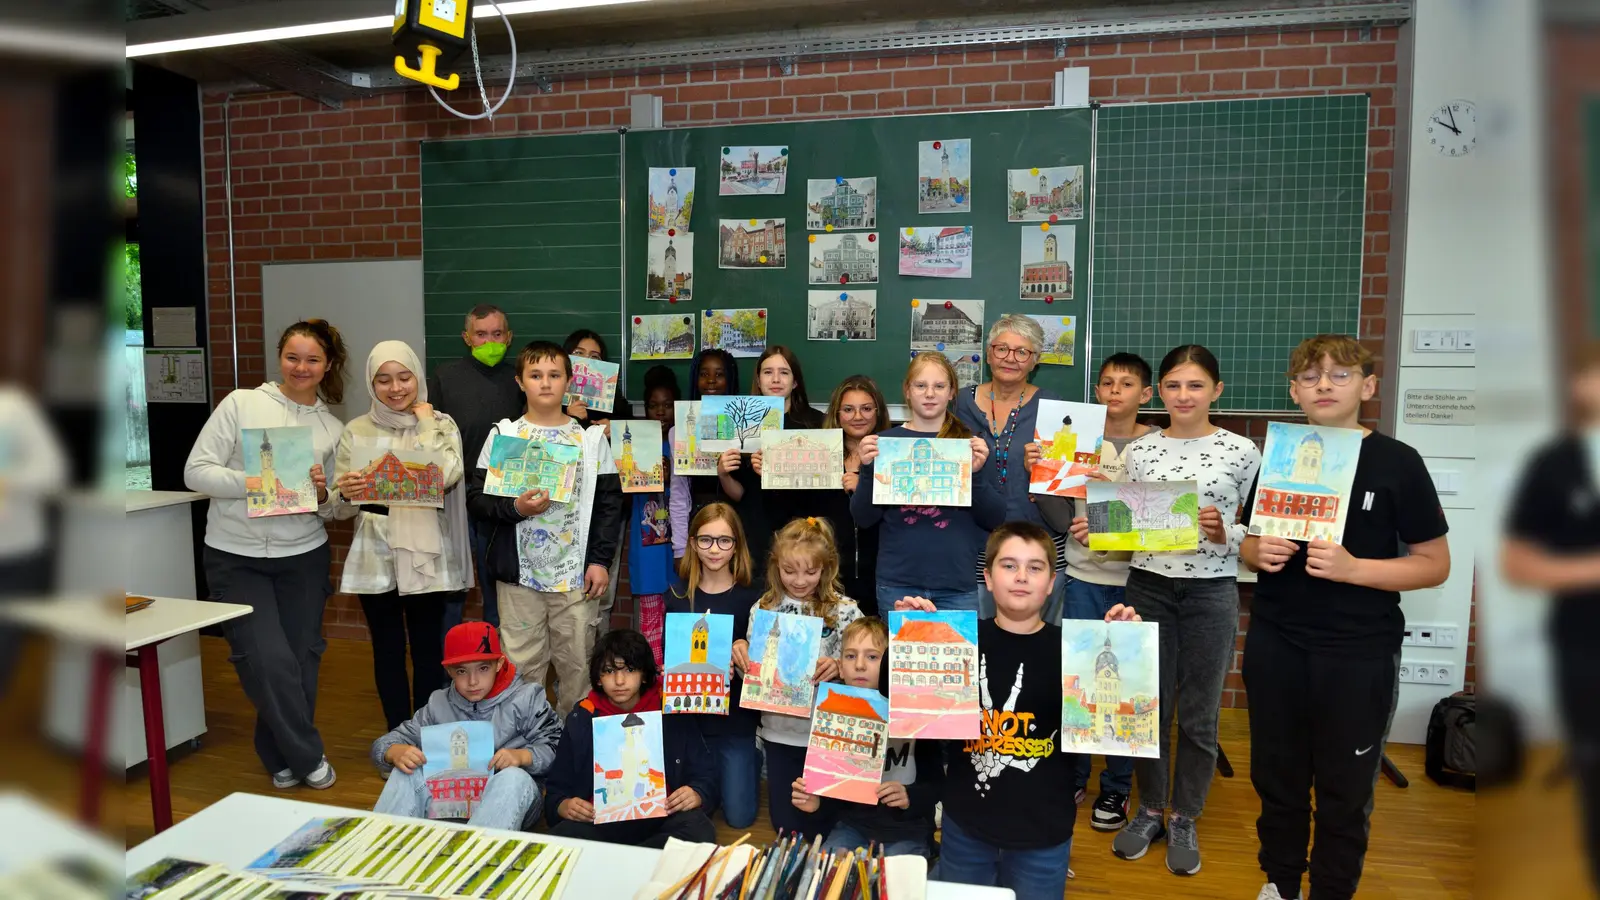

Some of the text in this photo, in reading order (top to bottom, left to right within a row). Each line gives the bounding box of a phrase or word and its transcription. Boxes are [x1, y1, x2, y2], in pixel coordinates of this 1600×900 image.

[1361, 491, 1375, 511] N
[981, 709, 1035, 737] NOT
[884, 741, 910, 772] M
[962, 734, 1055, 758] IMPRESSED
